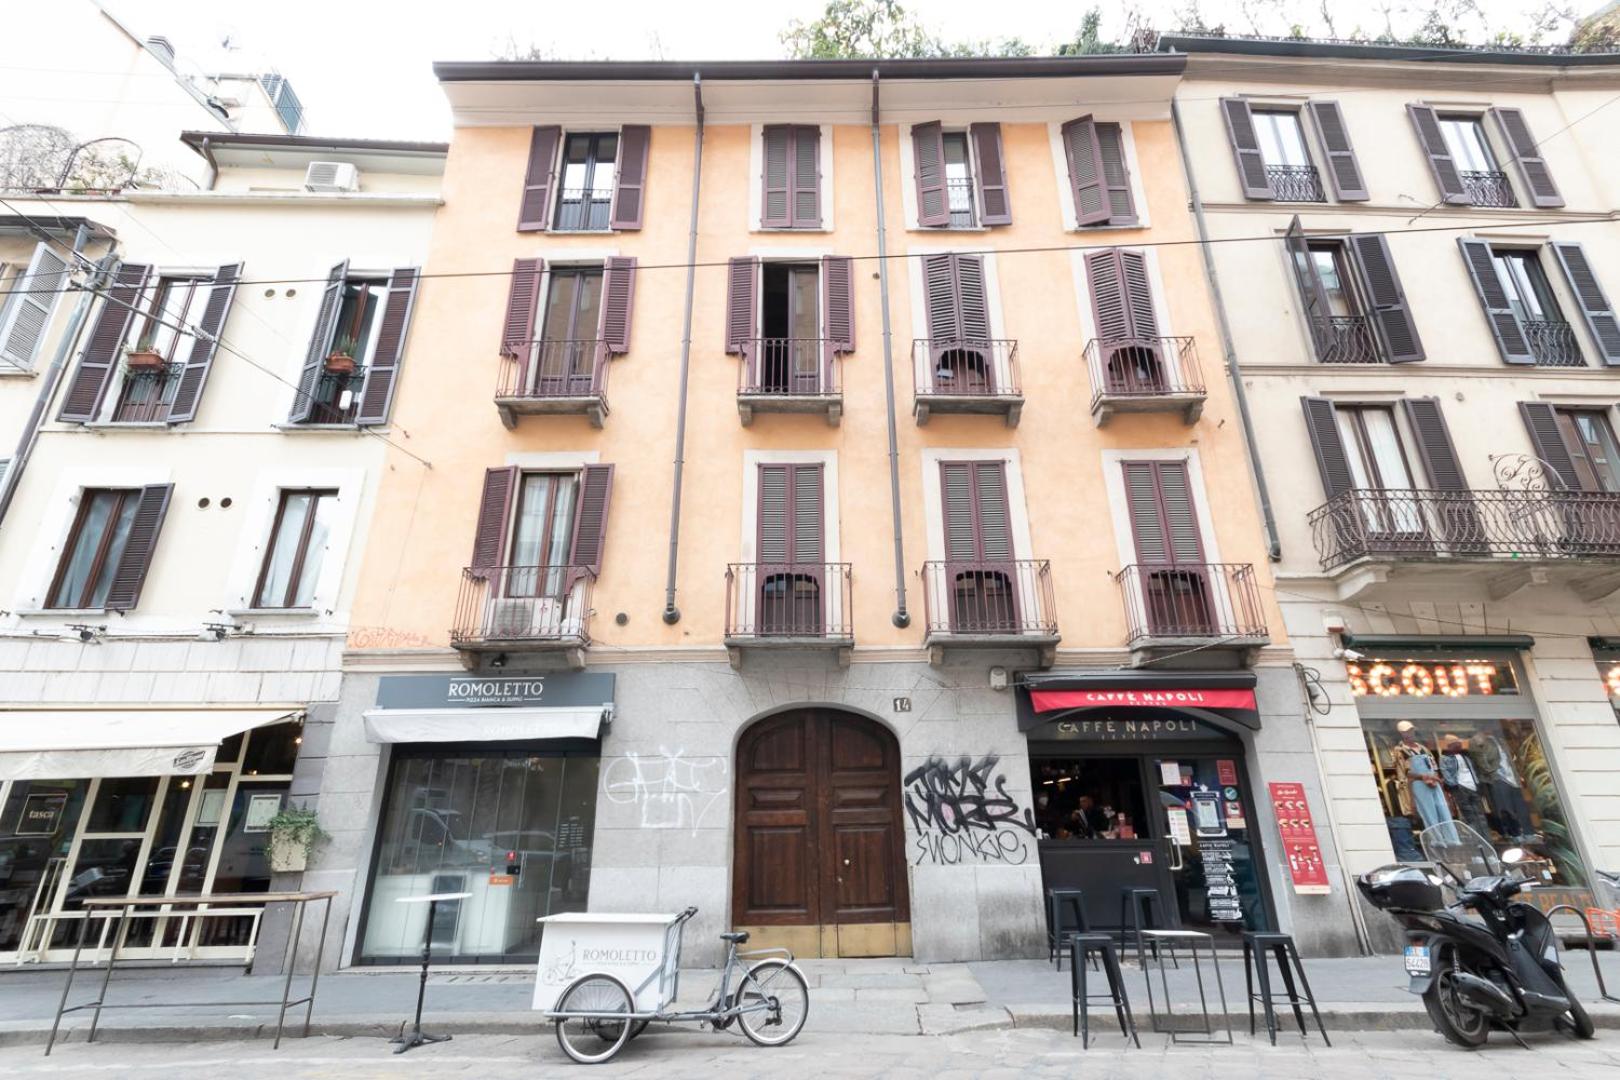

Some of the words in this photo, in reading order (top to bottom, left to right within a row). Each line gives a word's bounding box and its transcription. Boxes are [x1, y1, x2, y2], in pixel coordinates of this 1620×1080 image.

[1347, 664, 1496, 697] SCOUT
[448, 682, 543, 696] ROMOLETTO
[1143, 692, 1204, 702] NAPOLI
[894, 699, 910, 712] 14
[1057, 717, 1116, 733] CAFFÈ
[1125, 720, 1197, 732] NAPOLI
[29, 810, 55, 819] tasca
[583, 949, 657, 961] ROMOLETTO
